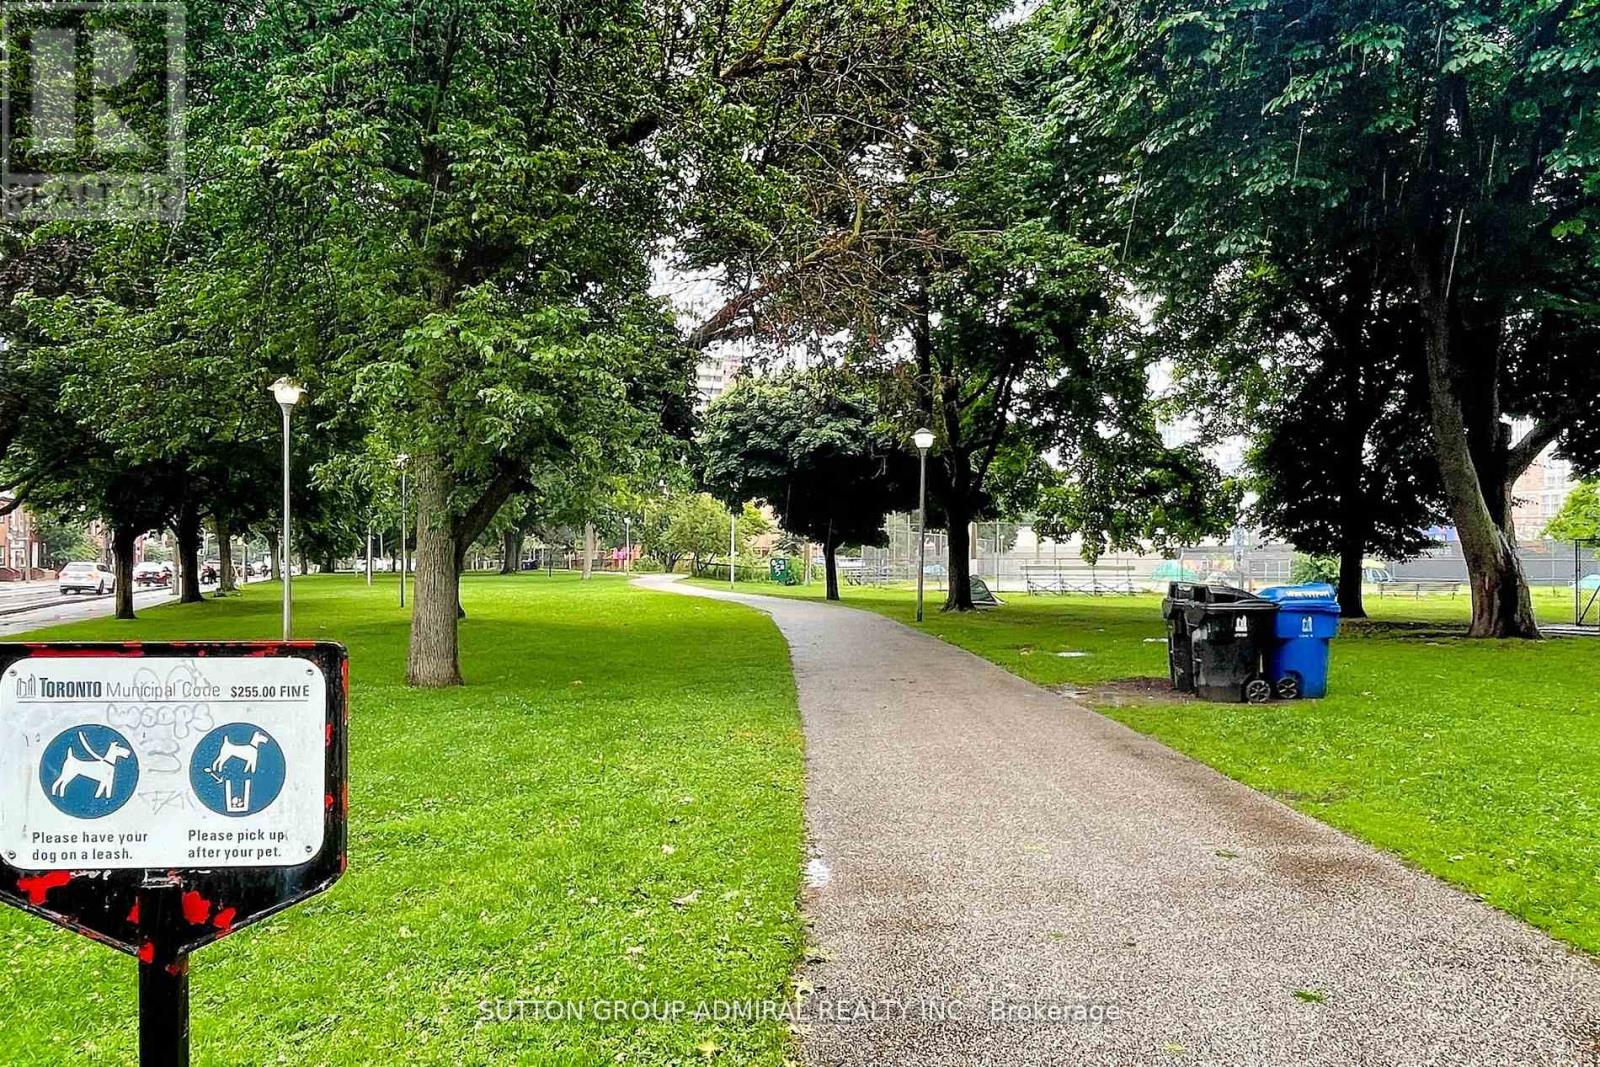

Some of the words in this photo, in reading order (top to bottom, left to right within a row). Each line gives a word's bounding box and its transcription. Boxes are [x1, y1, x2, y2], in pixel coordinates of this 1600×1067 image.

[39, 677, 102, 698] TORONTO
[106, 681, 176, 700] Municipal
[182, 681, 221, 698] Code
[230, 685, 276, 698] $255.00
[280, 685, 310, 698] FINE
[32, 831, 78, 844] Please
[82, 831, 115, 843] have
[118, 832, 148, 845] your
[188, 829, 233, 842] Please
[237, 828, 265, 844] pick
[269, 831, 284, 843] up
[32, 848, 57, 864] dog
[60, 851, 77, 861] on
[81, 851, 88, 860] a
[92, 847, 133, 860] leash.
[188, 846, 221, 858] after
[224, 847, 254, 861] your
[257, 846, 282, 860] pet.
